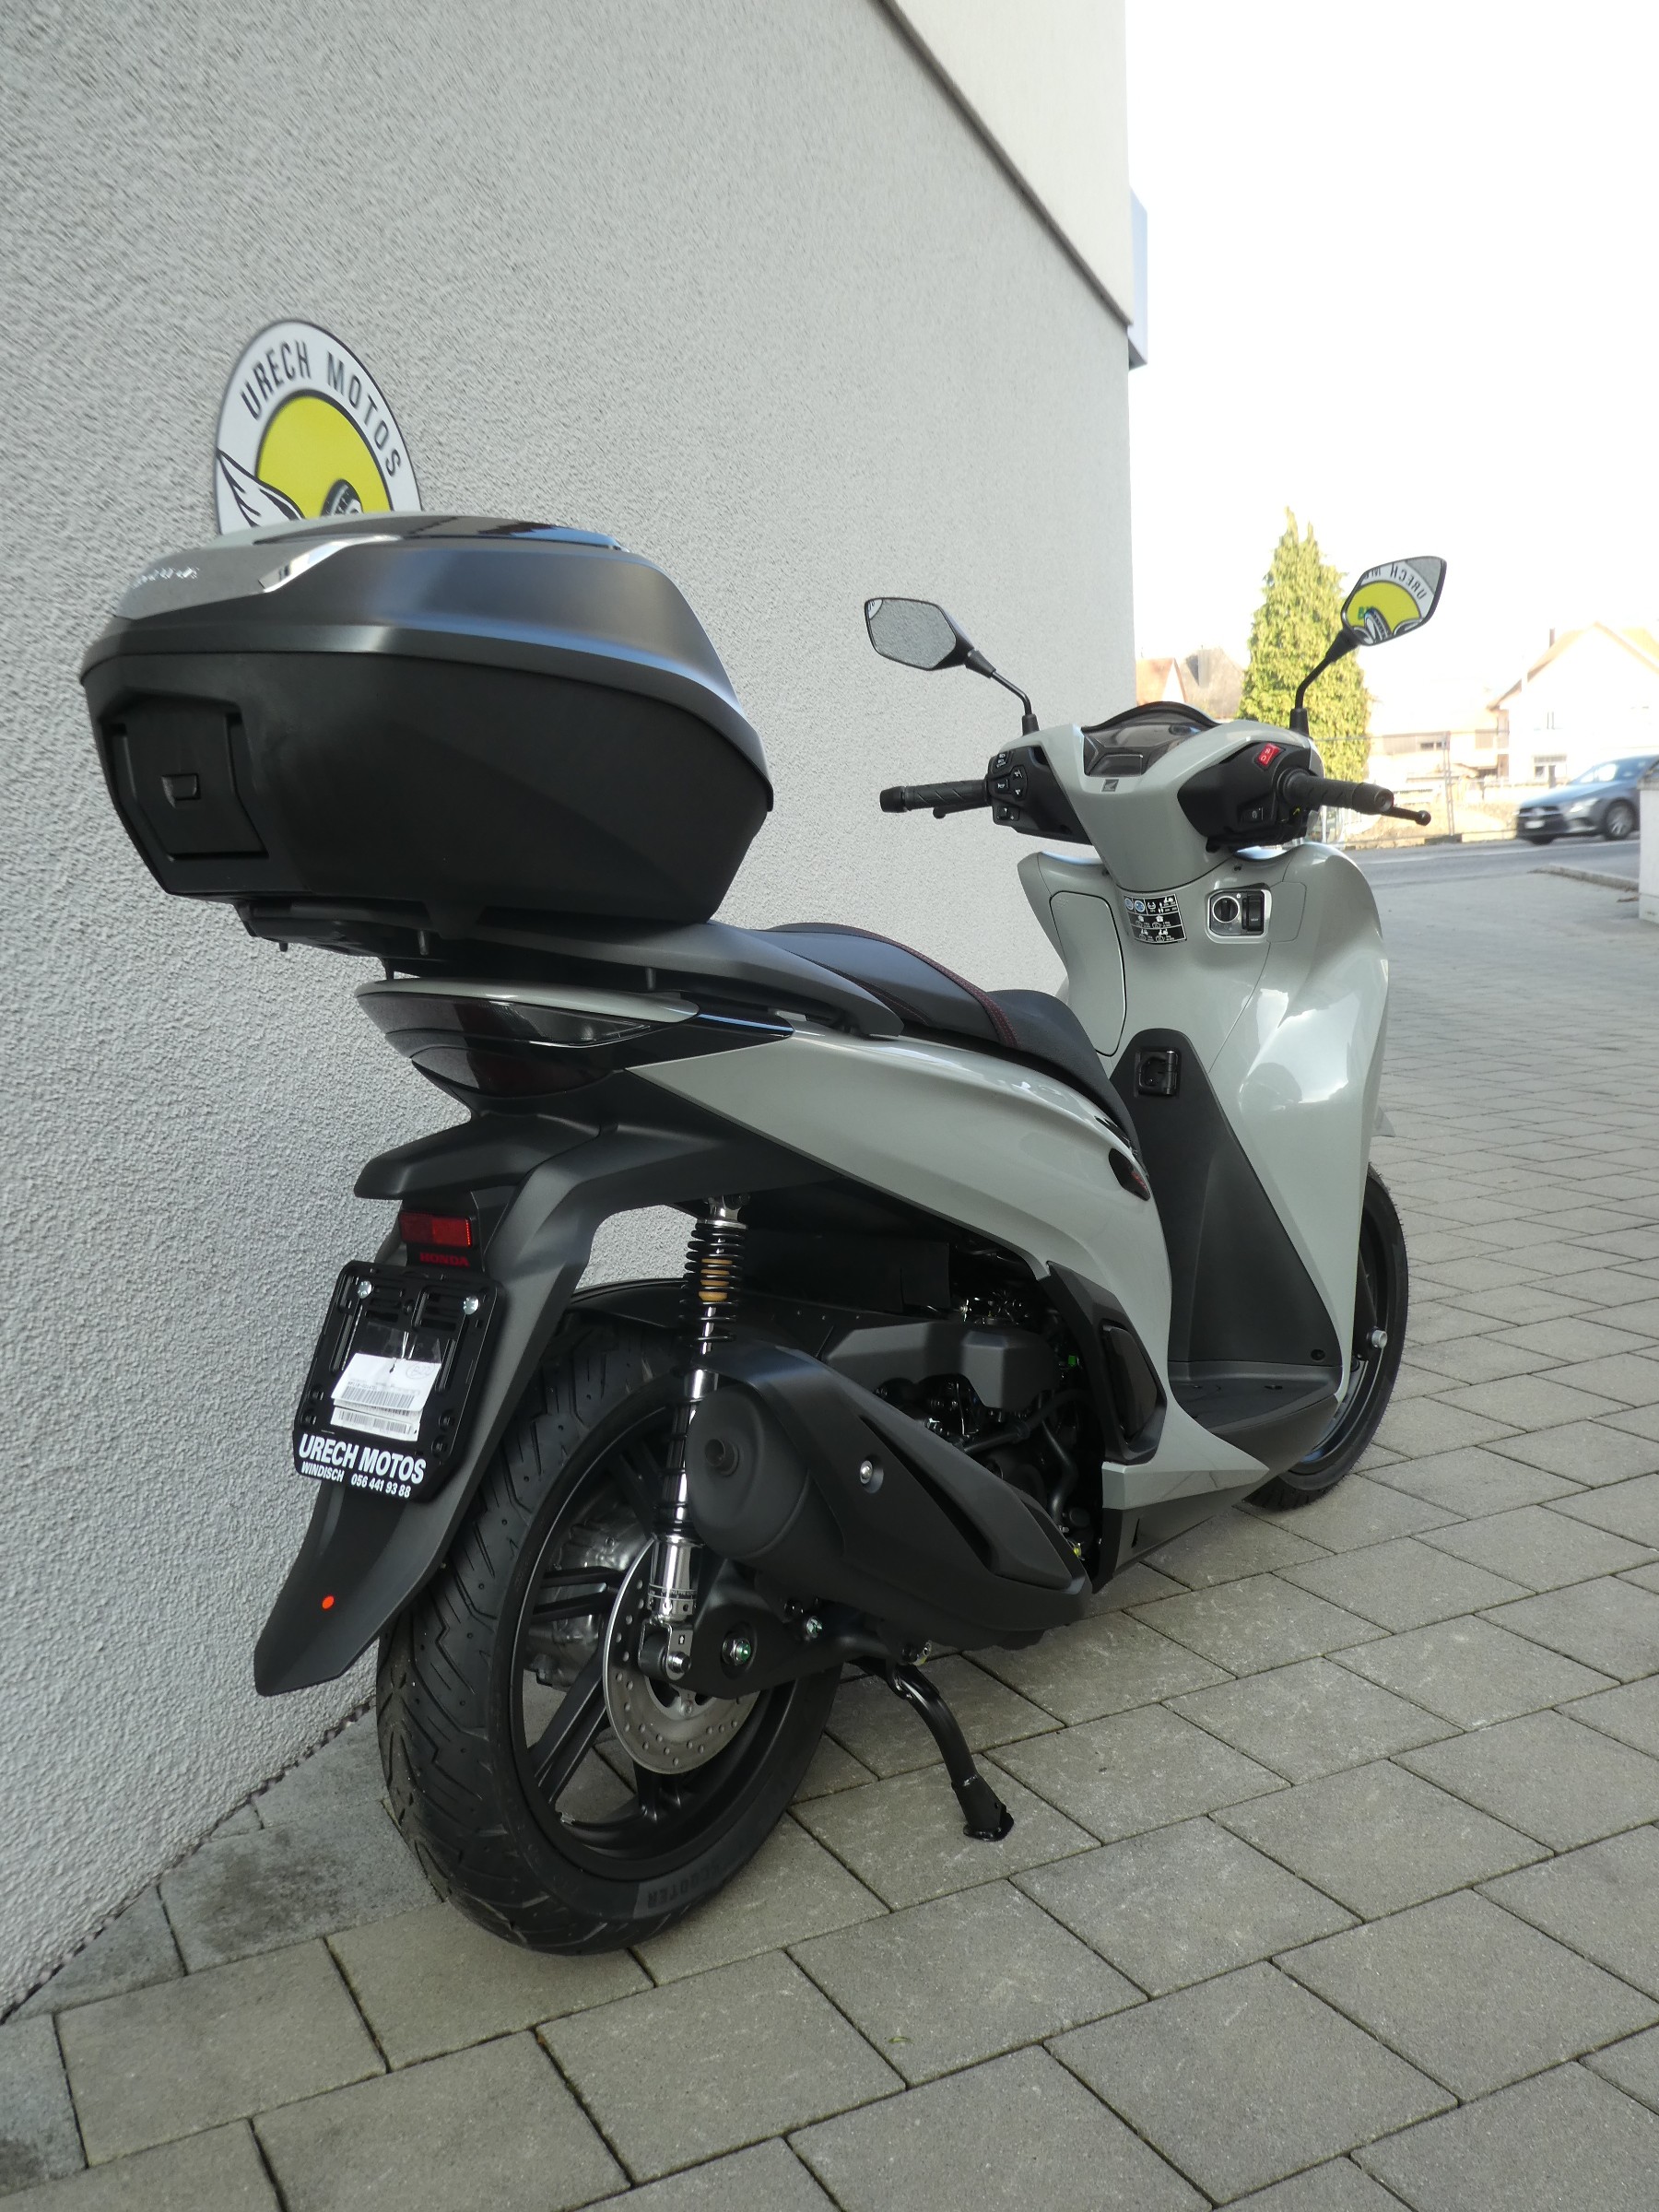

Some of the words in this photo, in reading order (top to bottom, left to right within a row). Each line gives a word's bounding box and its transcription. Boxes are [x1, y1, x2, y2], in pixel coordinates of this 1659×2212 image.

[240, 340, 311, 420] URECH
[327, 351, 401, 477] MOTOS
[419, 1252, 470, 1267] HONDA
[299, 1433, 359, 1469] URECH
[359, 1447, 427, 1484] MOTOS
[300, 1461, 346, 1483] WINDISCH
[350, 1473, 368, 1488] 056
[369, 1477, 384, 1492] 441
[385, 1480, 398, 1495] 93
[398, 1484, 411, 1499] 88
